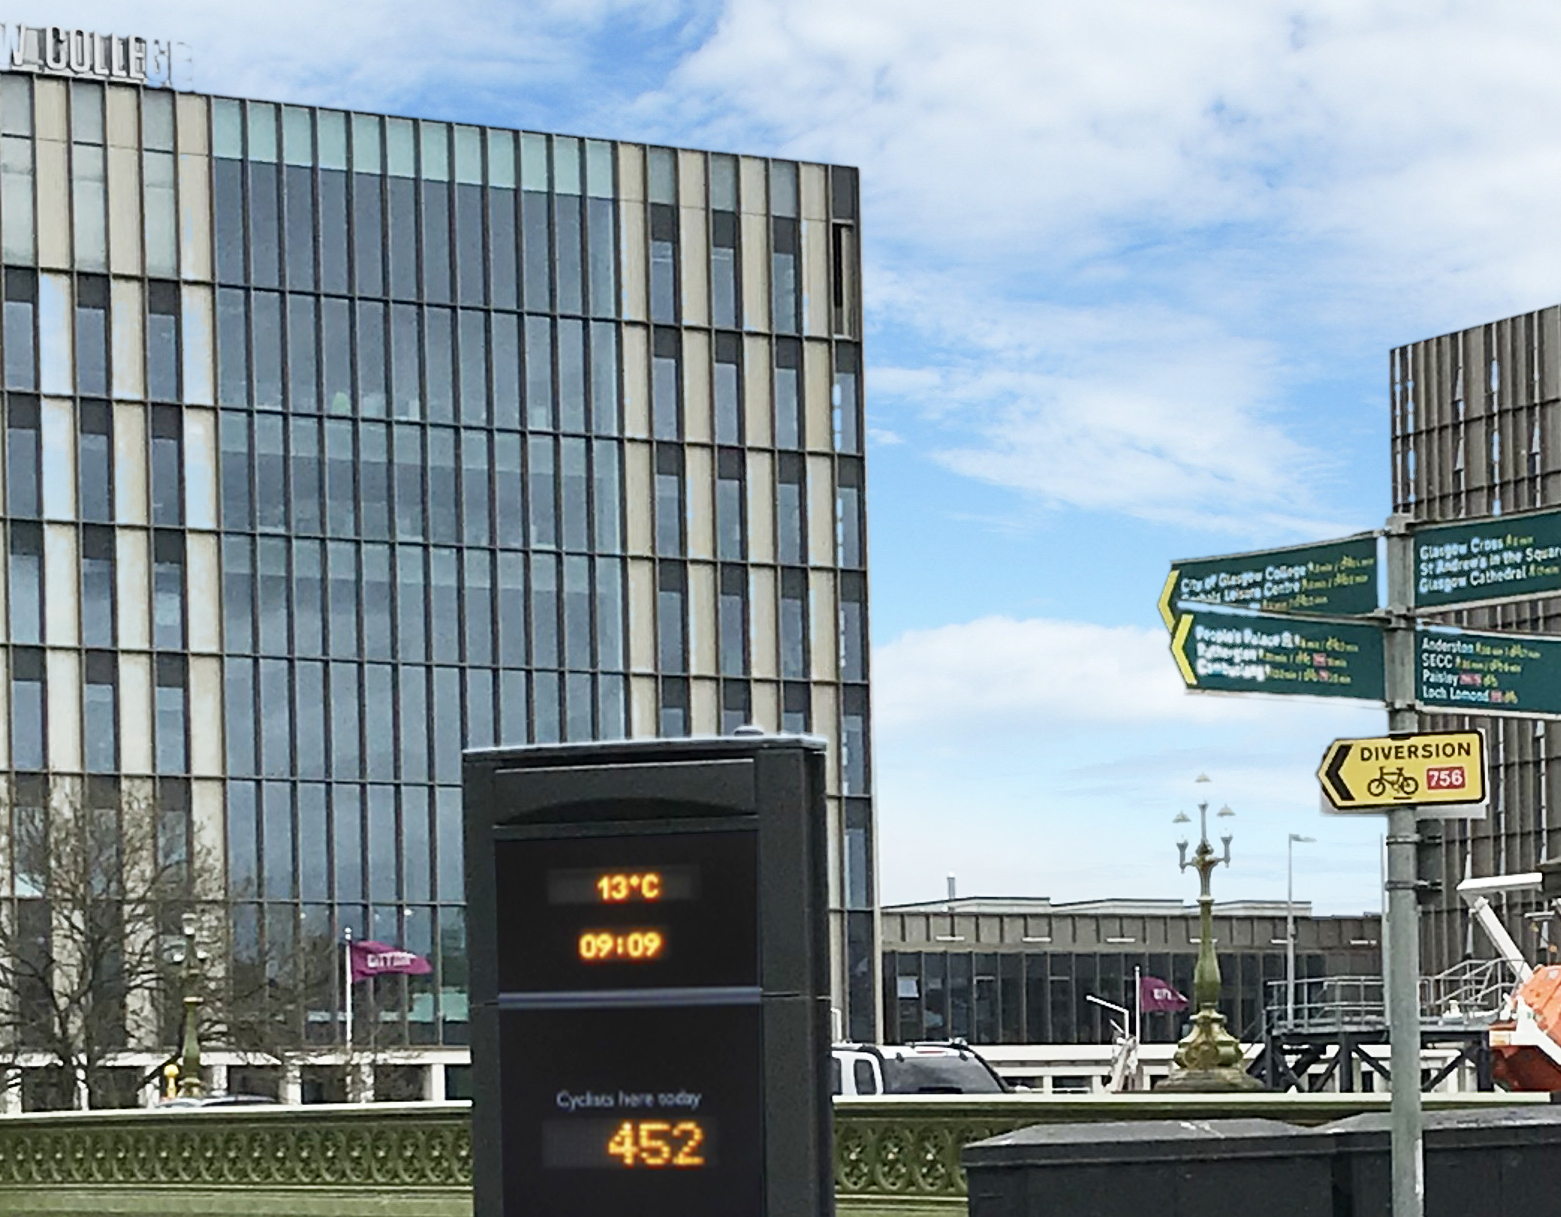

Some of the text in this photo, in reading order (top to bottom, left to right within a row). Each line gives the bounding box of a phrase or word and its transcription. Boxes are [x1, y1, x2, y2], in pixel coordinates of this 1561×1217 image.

[45, 24, 193, 92] COLLEGE
[1419, 542, 1468, 560] Glasgow
[1470, 536, 1504, 553] Cross
[1420, 562, 1434, 576] St
[1436, 555, 1488, 575] Andrew's
[1502, 550, 1523, 564] the
[1219, 571, 1263, 587] Glasgow
[1265, 565, 1307, 580] College
[1419, 575, 1467, 594] Glasgow
[1469, 566, 1527, 586] Cathedral
[1422, 637, 1474, 654] Anderston
[1422, 653, 1453, 668] SECC
[1422, 669, 1458, 686] Paisley
[1422, 686, 1447, 699] Loch
[1450, 687, 1490, 702] Lomond
[1360, 742, 1471, 762] DIVERSION
[1429, 770, 1463, 787] 756
[597, 871, 660, 901] 13°C
[580, 931, 662, 960] 09:09
[556, 1090, 702, 1111] Cyclists here today
[607, 1121, 706, 1167] 452
